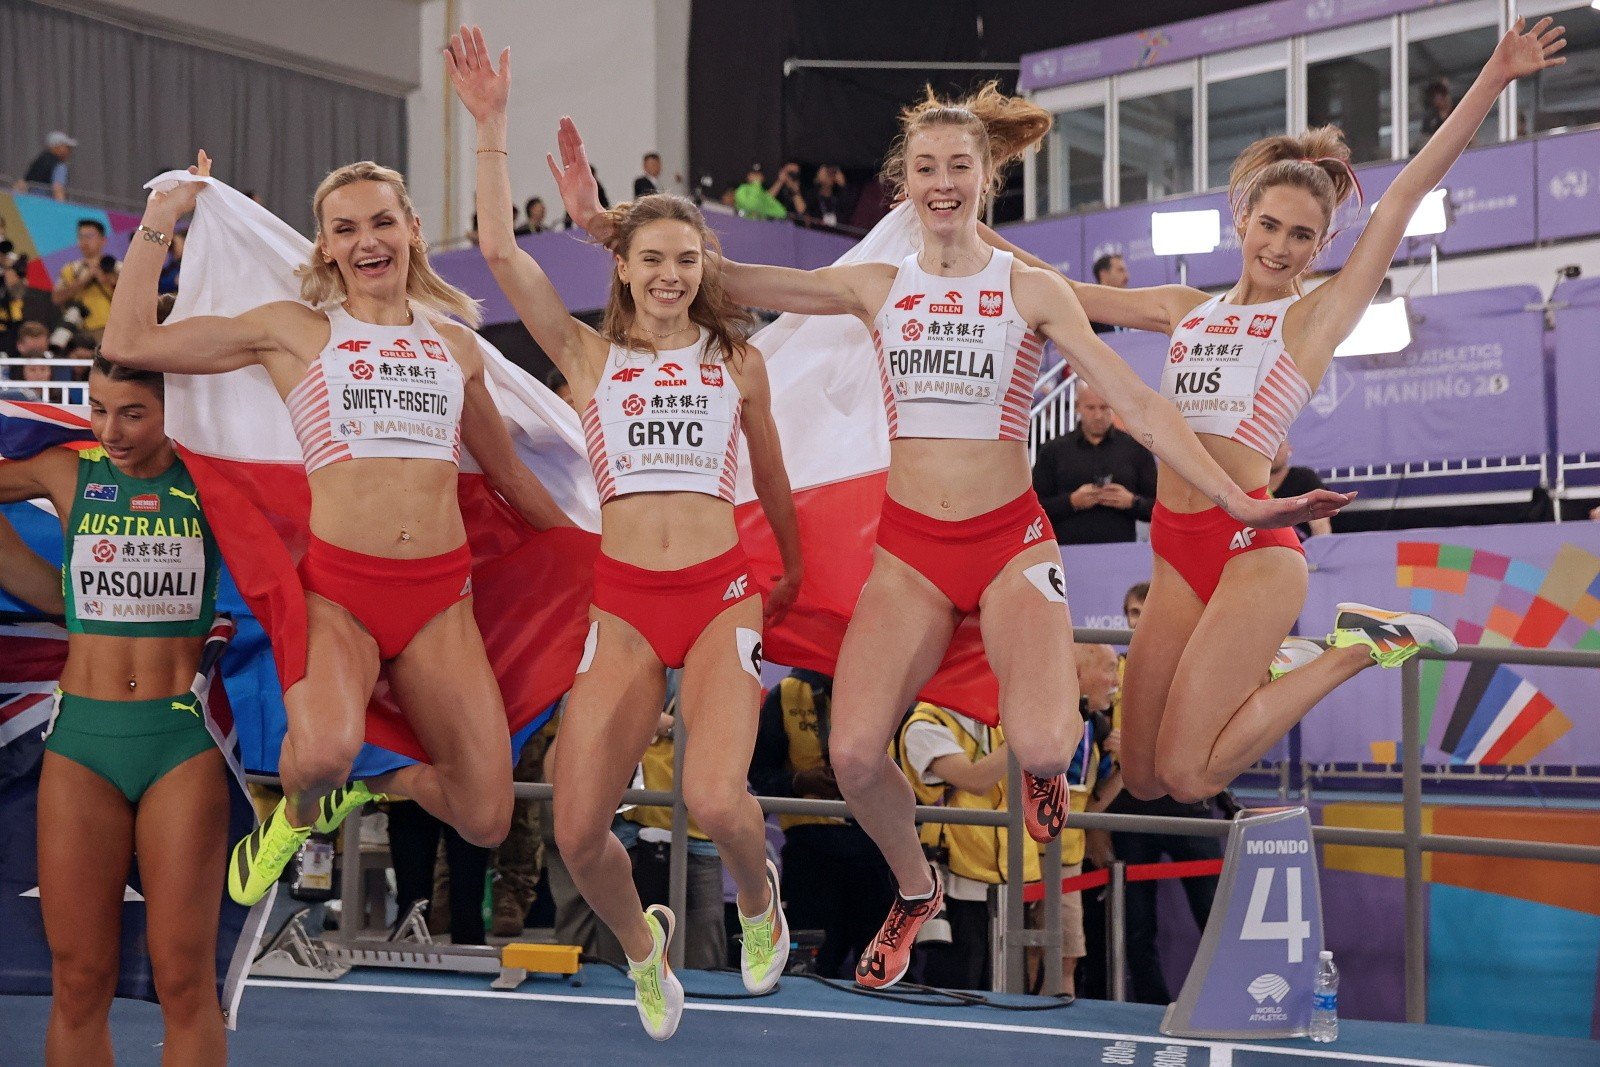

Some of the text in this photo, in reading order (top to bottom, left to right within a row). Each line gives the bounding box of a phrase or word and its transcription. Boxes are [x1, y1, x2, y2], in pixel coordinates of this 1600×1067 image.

[895, 294, 926, 311] 4F
[930, 305, 961, 313] ORLEN
[928, 320, 986, 338] 南京银行
[1207, 325, 1236, 334] ORLEN
[337, 340, 371, 352] 4F
[381, 350, 415, 358] ORLEN
[1191, 343, 1244, 357] 南京银行
[379, 362, 437, 380] 南京银行
[889, 349, 994, 379] FORMELLA
[411, 378, 438, 386] NANJING
[611, 368, 645, 382] 4F
[654, 379, 687, 387] ORLEN
[1174, 367, 1222, 395] KUŚ
[914, 380, 991, 398] NANJING 25
[342, 384, 448, 416] ŚWIĘTY-ERSETIC
[651, 394, 709, 409] 南京银行
[1229, 400, 1247, 412] 25
[373, 420, 448, 440] NANJING 25
[628, 421, 703, 447] GRYC
[641, 453, 719, 470] NANJING 25
[77, 512, 203, 537] AUSTRALIA
[1023, 515, 1044, 544] 4F
[1228, 527, 1257, 551] 4F
[122, 541, 183, 558] 南京银行
[80, 570, 197, 598] PASQUALI
[722, 573, 748, 601] 4F
[112, 601, 194, 618] NANJING 25
[1246, 840, 1309, 855] MONDO
[1239, 867, 1311, 963] 4
[1249, 1013, 1288, 1022] ATHLETICS
[1255, 1006, 1282, 1014] WORLD
